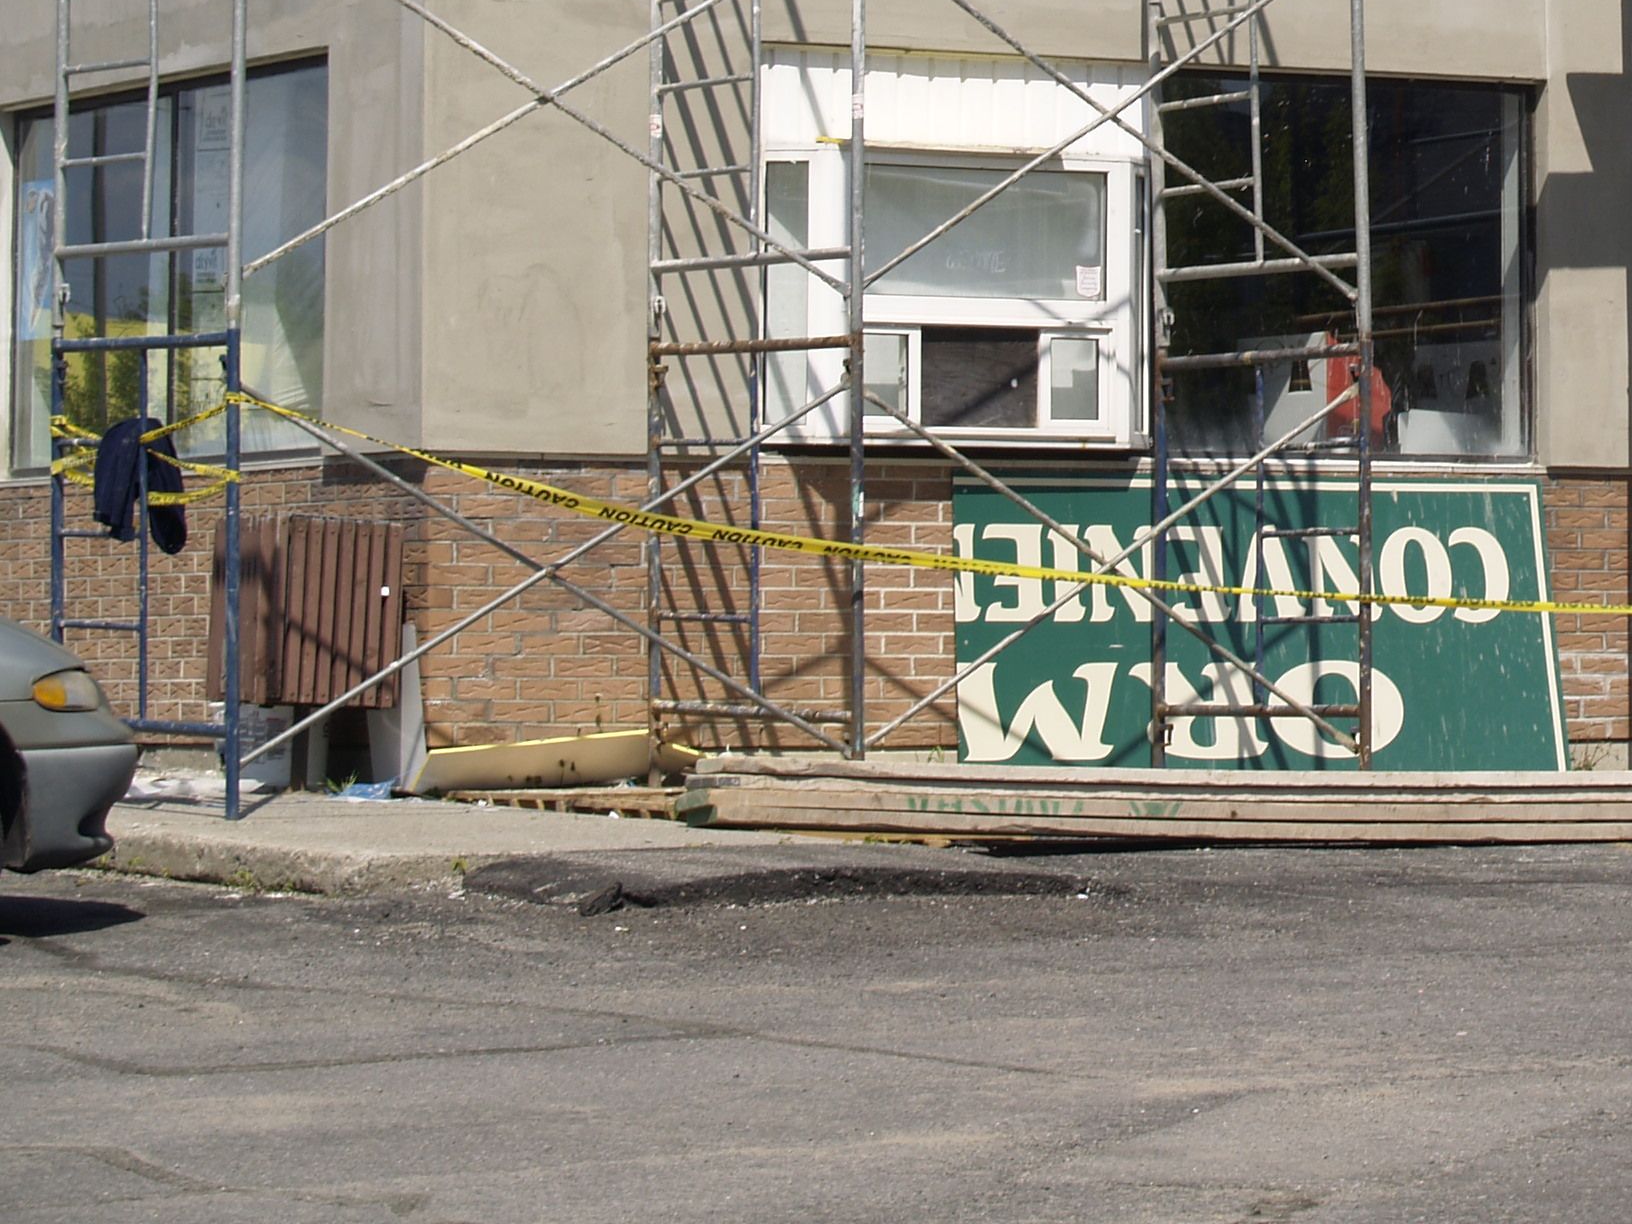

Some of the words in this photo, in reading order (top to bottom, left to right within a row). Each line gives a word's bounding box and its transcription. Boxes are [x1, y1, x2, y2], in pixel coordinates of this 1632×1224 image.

[484, 471, 580, 509] CAUTION
[597, 506, 693, 536] CAUTION
[711, 530, 804, 550] CAUTION
[957, 659, 1405, 761] ORM
